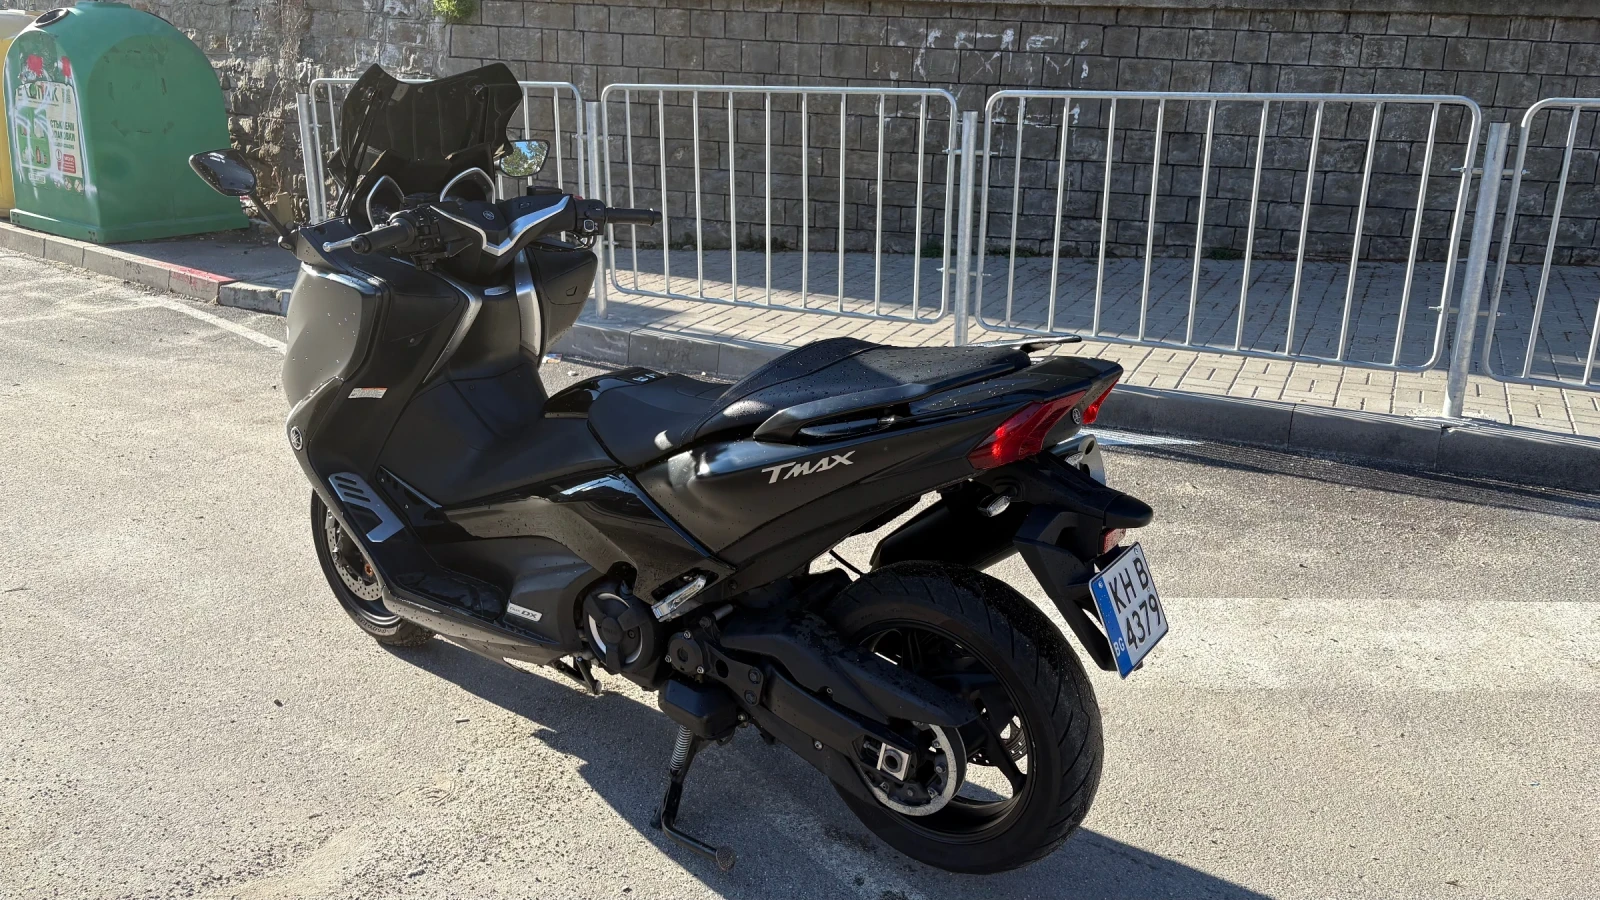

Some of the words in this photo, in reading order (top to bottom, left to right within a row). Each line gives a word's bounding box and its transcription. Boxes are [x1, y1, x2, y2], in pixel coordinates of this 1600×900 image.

[761, 450, 856, 484] TMAX
[1108, 567, 1137, 614] KH
[1133, 557, 1149, 591] B
[521, 610, 538, 619] DX
[1125, 593, 1161, 650] 4379
[1113, 637, 1126, 657] BG
